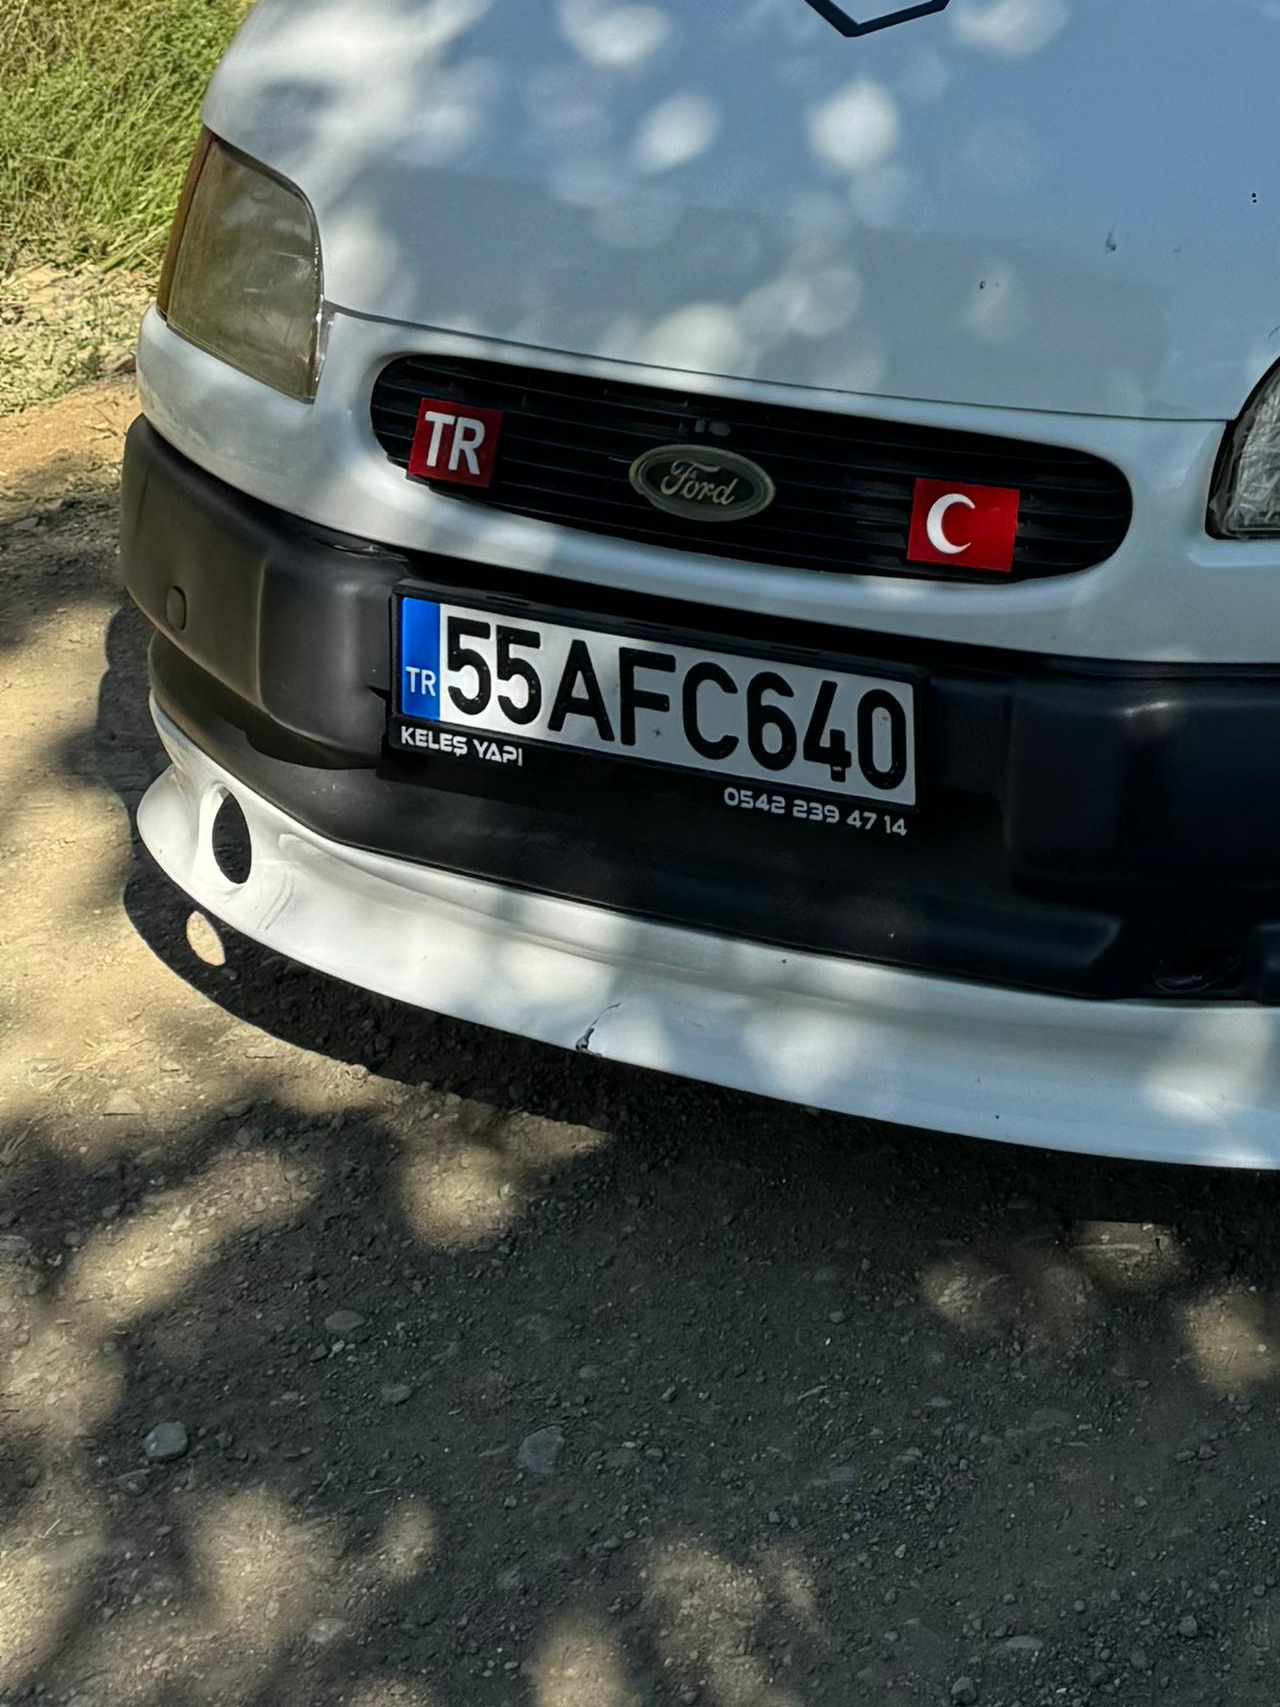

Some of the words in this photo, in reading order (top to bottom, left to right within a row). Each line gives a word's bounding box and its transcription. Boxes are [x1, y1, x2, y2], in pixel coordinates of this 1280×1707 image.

[423, 410, 486, 477] TR
[660, 459, 739, 506] Ford
[405, 665, 437, 697] TR
[446, 614, 910, 791] 55AFC640
[400, 725, 469, 757] KELEŞ
[472, 738, 523, 767] YAPI
[723, 787, 787, 815] 0542
[792, 799, 840, 824] 239
[846, 809, 878, 831] 47
[883, 814, 908, 836] 14
